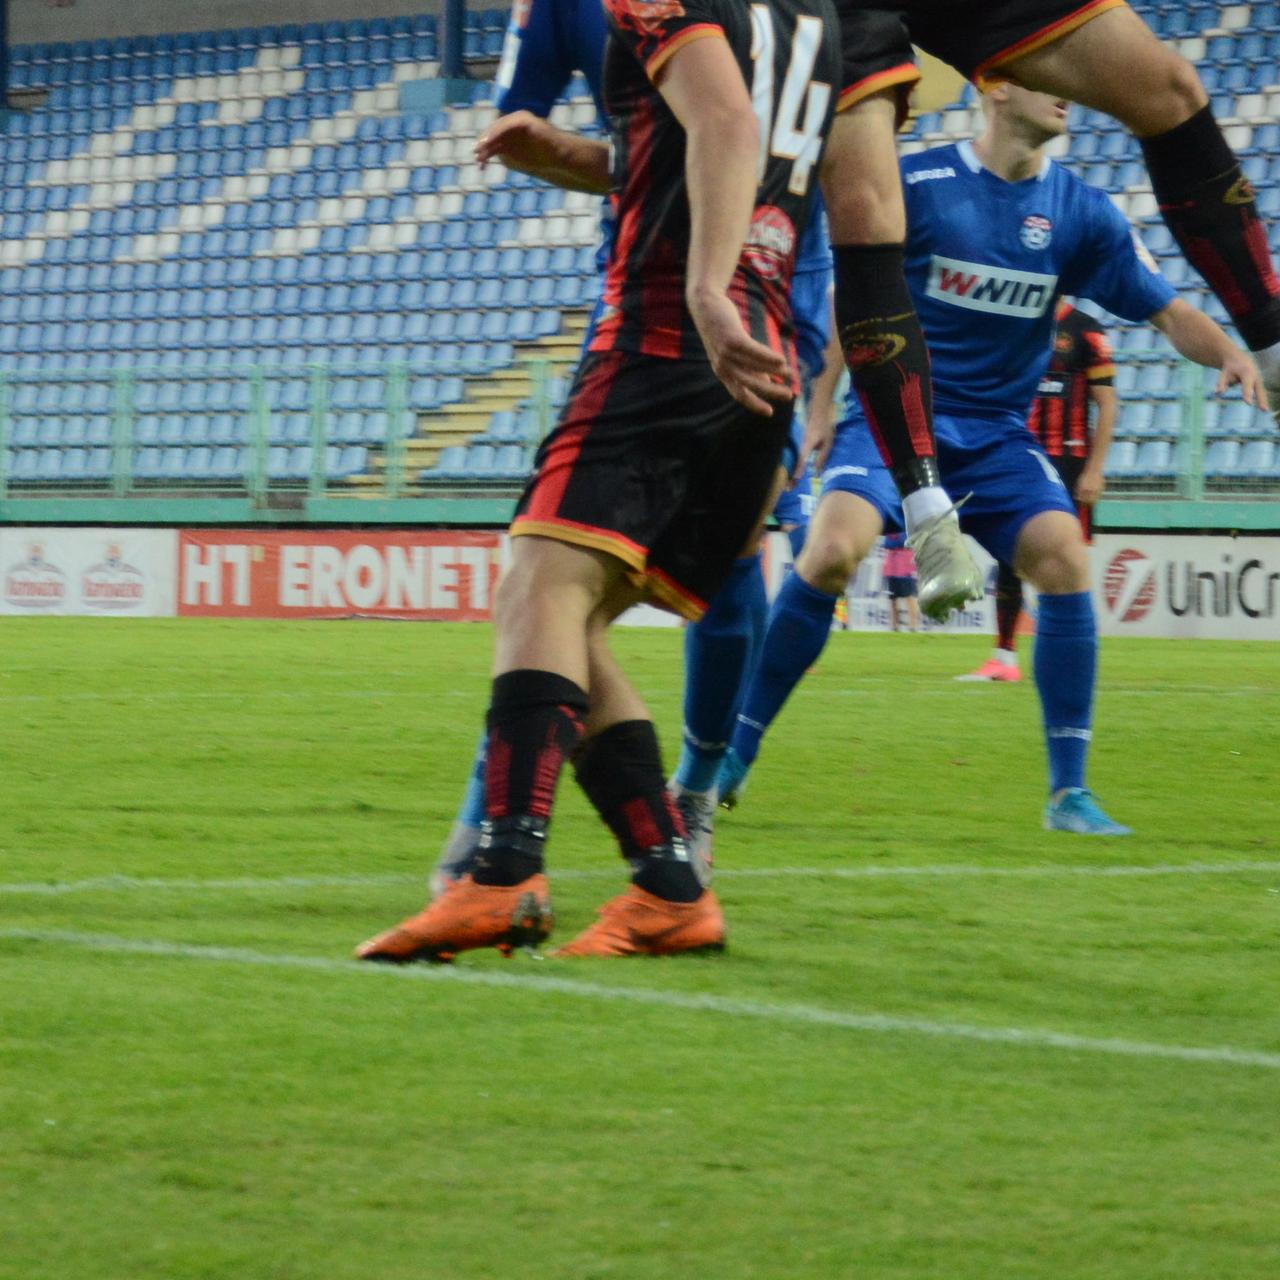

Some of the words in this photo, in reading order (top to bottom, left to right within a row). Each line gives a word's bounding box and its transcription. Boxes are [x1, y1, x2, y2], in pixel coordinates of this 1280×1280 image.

[749, 3, 832, 197] 14
[180, 543, 252, 607] HT
[276, 543, 493, 610] ERONET
